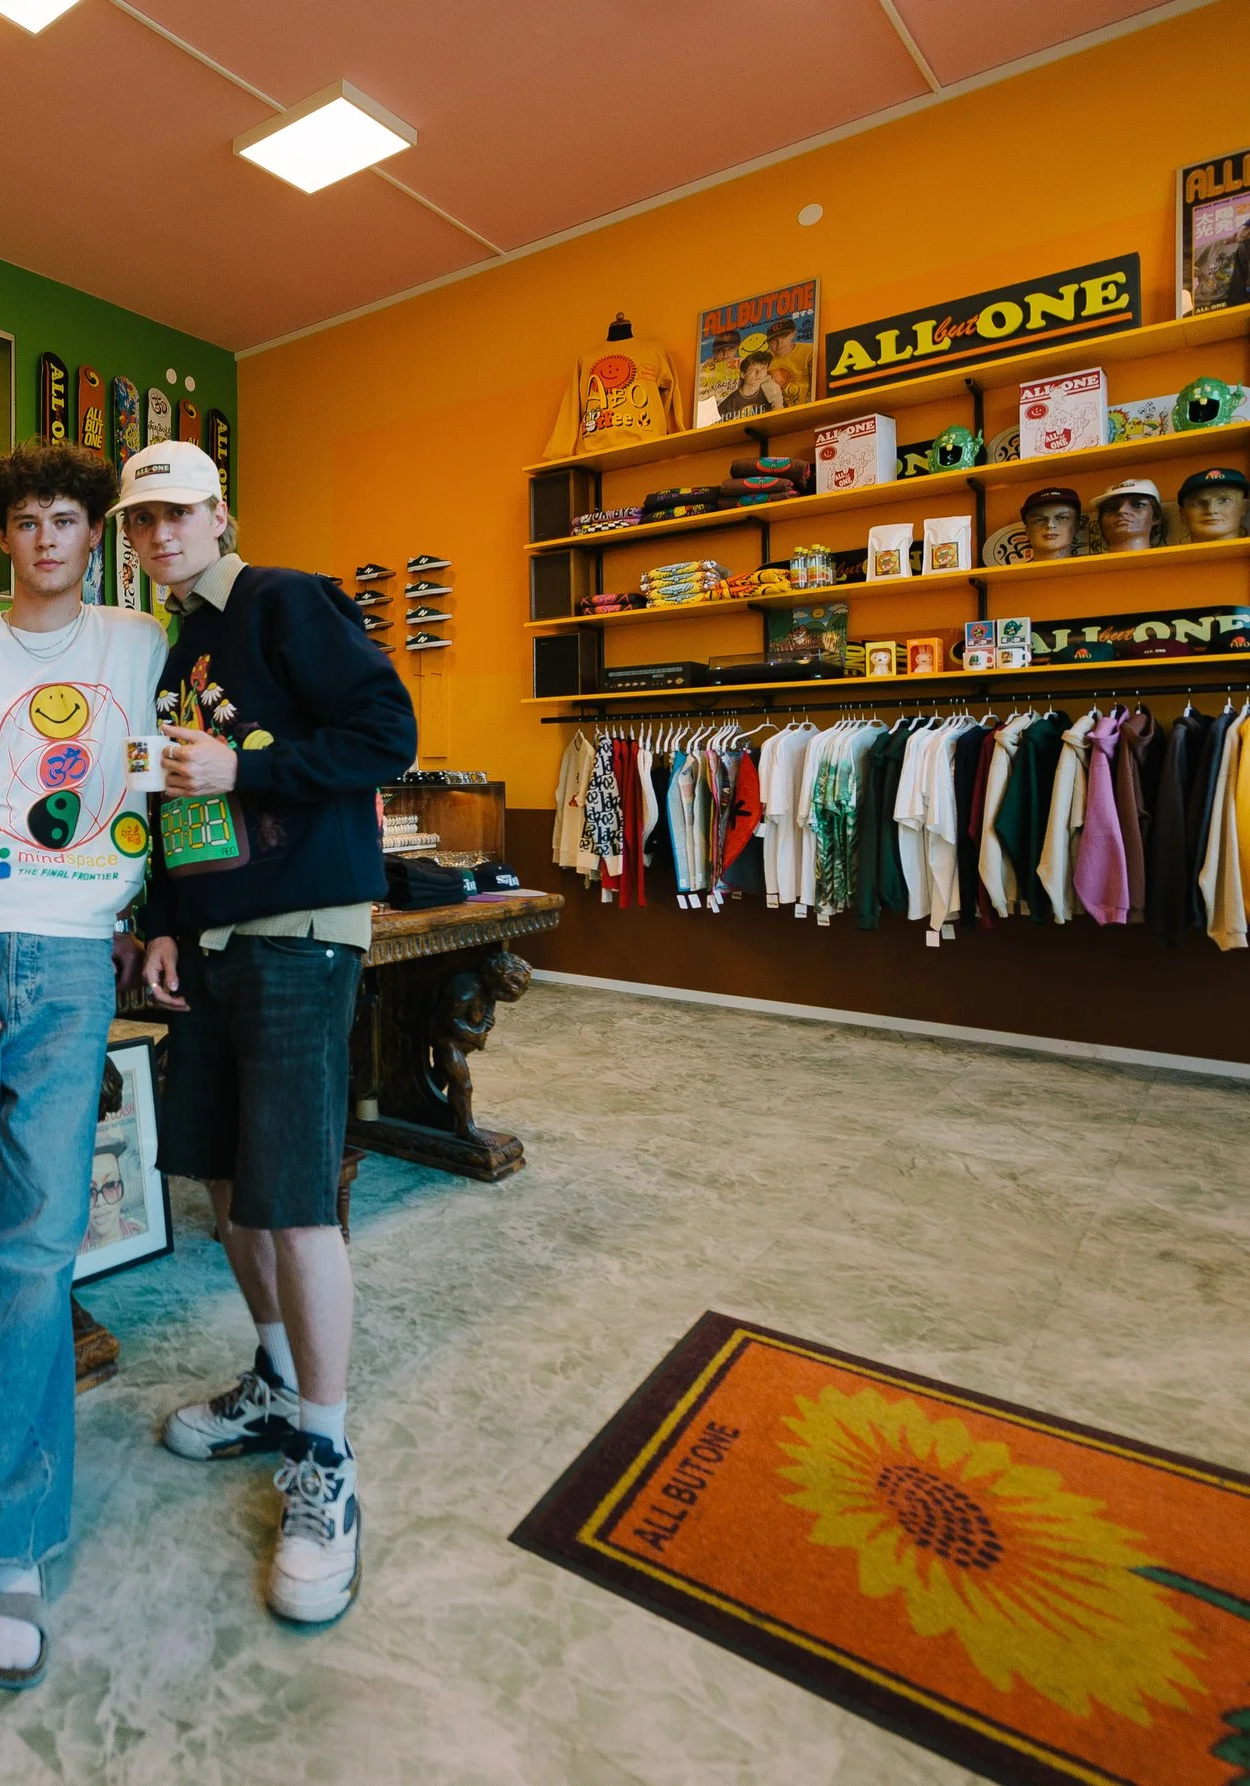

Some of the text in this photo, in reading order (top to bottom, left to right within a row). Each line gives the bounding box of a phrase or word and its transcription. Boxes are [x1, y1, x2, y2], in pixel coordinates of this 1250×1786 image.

[830, 271, 1129, 376] ALL but ONE
[1061, 375, 1099, 391] ONE
[86, 407, 102, 422] ALL
[85, 420, 103, 435] BUT
[845, 420, 876, 435] ONE
[84, 433, 102, 449] ONE
[18, 851, 119, 869] mindspace
[18, 868, 119, 881] THE FINAL FRONTIER
[633, 1504, 688, 1551] ALL
